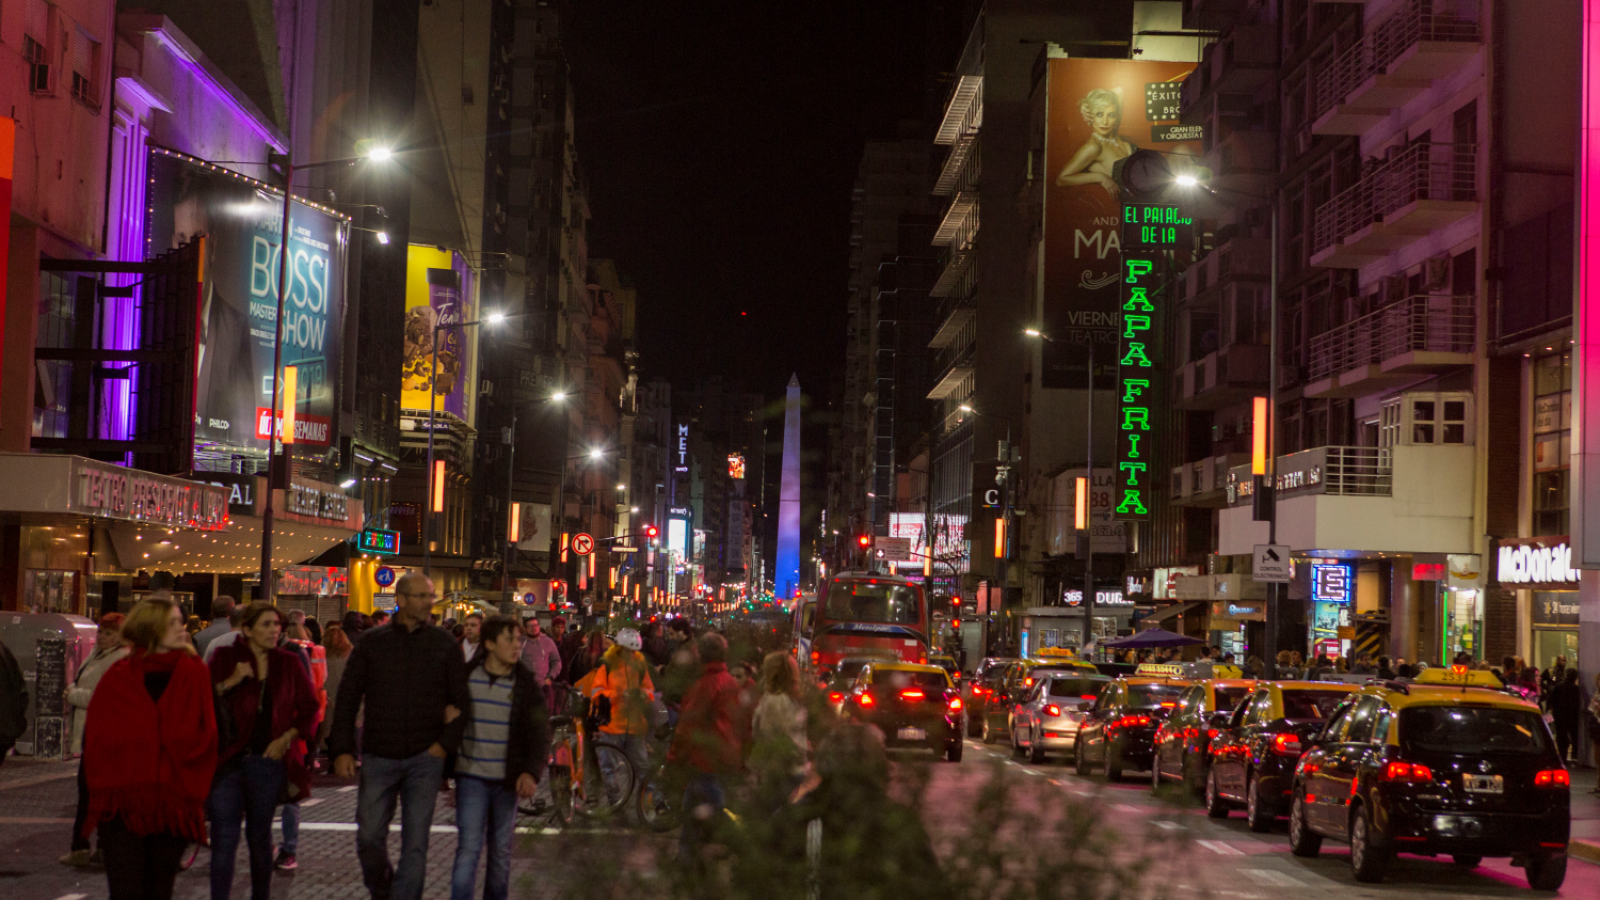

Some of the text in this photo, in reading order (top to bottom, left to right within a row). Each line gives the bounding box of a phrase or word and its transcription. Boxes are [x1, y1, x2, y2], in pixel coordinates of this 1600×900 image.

[255, 203, 294, 240] MARTN
[1124, 206, 1138, 223] EL
[1141, 226, 1157, 243] DE
[251, 235, 329, 315] BOSSI
[249, 301, 278, 321] MASTER
[1120, 260, 1155, 368] PAPA
[209, 418, 230, 430] PHILCO
[293, 420, 328, 442] SEMANAS
[677, 423, 689, 465] MET
[1115, 378, 1151, 515] FRITA
[1064, 591, 1135, 604] 365 DUR
[853, 622, 889, 632] Metalpar
